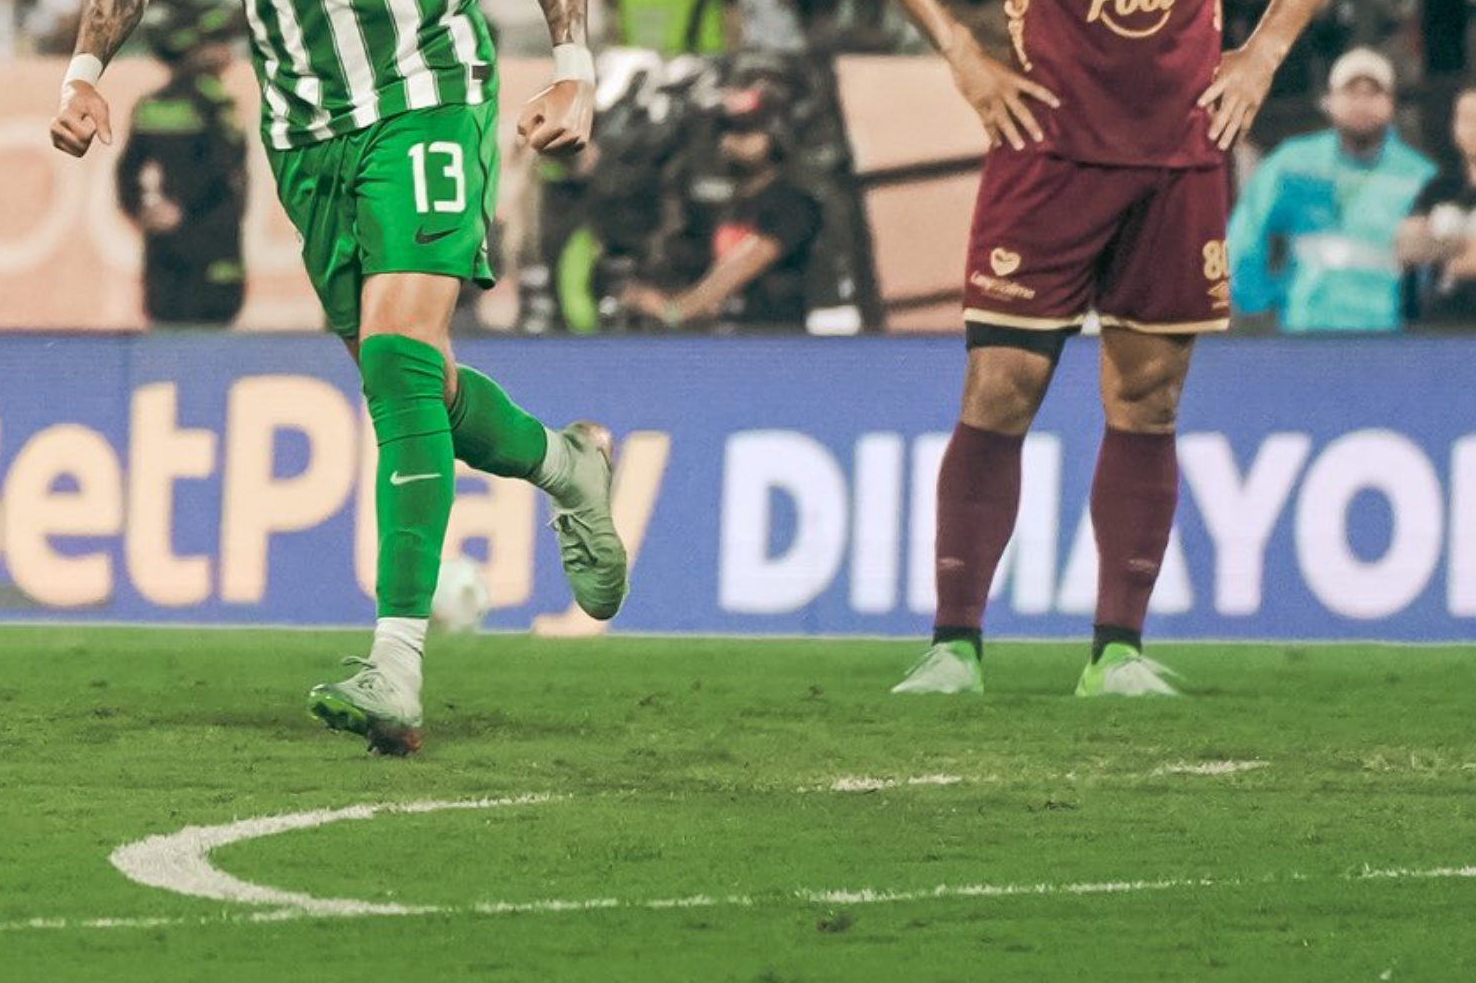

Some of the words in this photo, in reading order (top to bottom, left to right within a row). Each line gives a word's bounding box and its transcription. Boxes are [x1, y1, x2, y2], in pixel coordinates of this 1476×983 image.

[407, 140, 467, 214] 13
[1202, 239, 1228, 281] 8
[717, 427, 1476, 620] DIMYO
